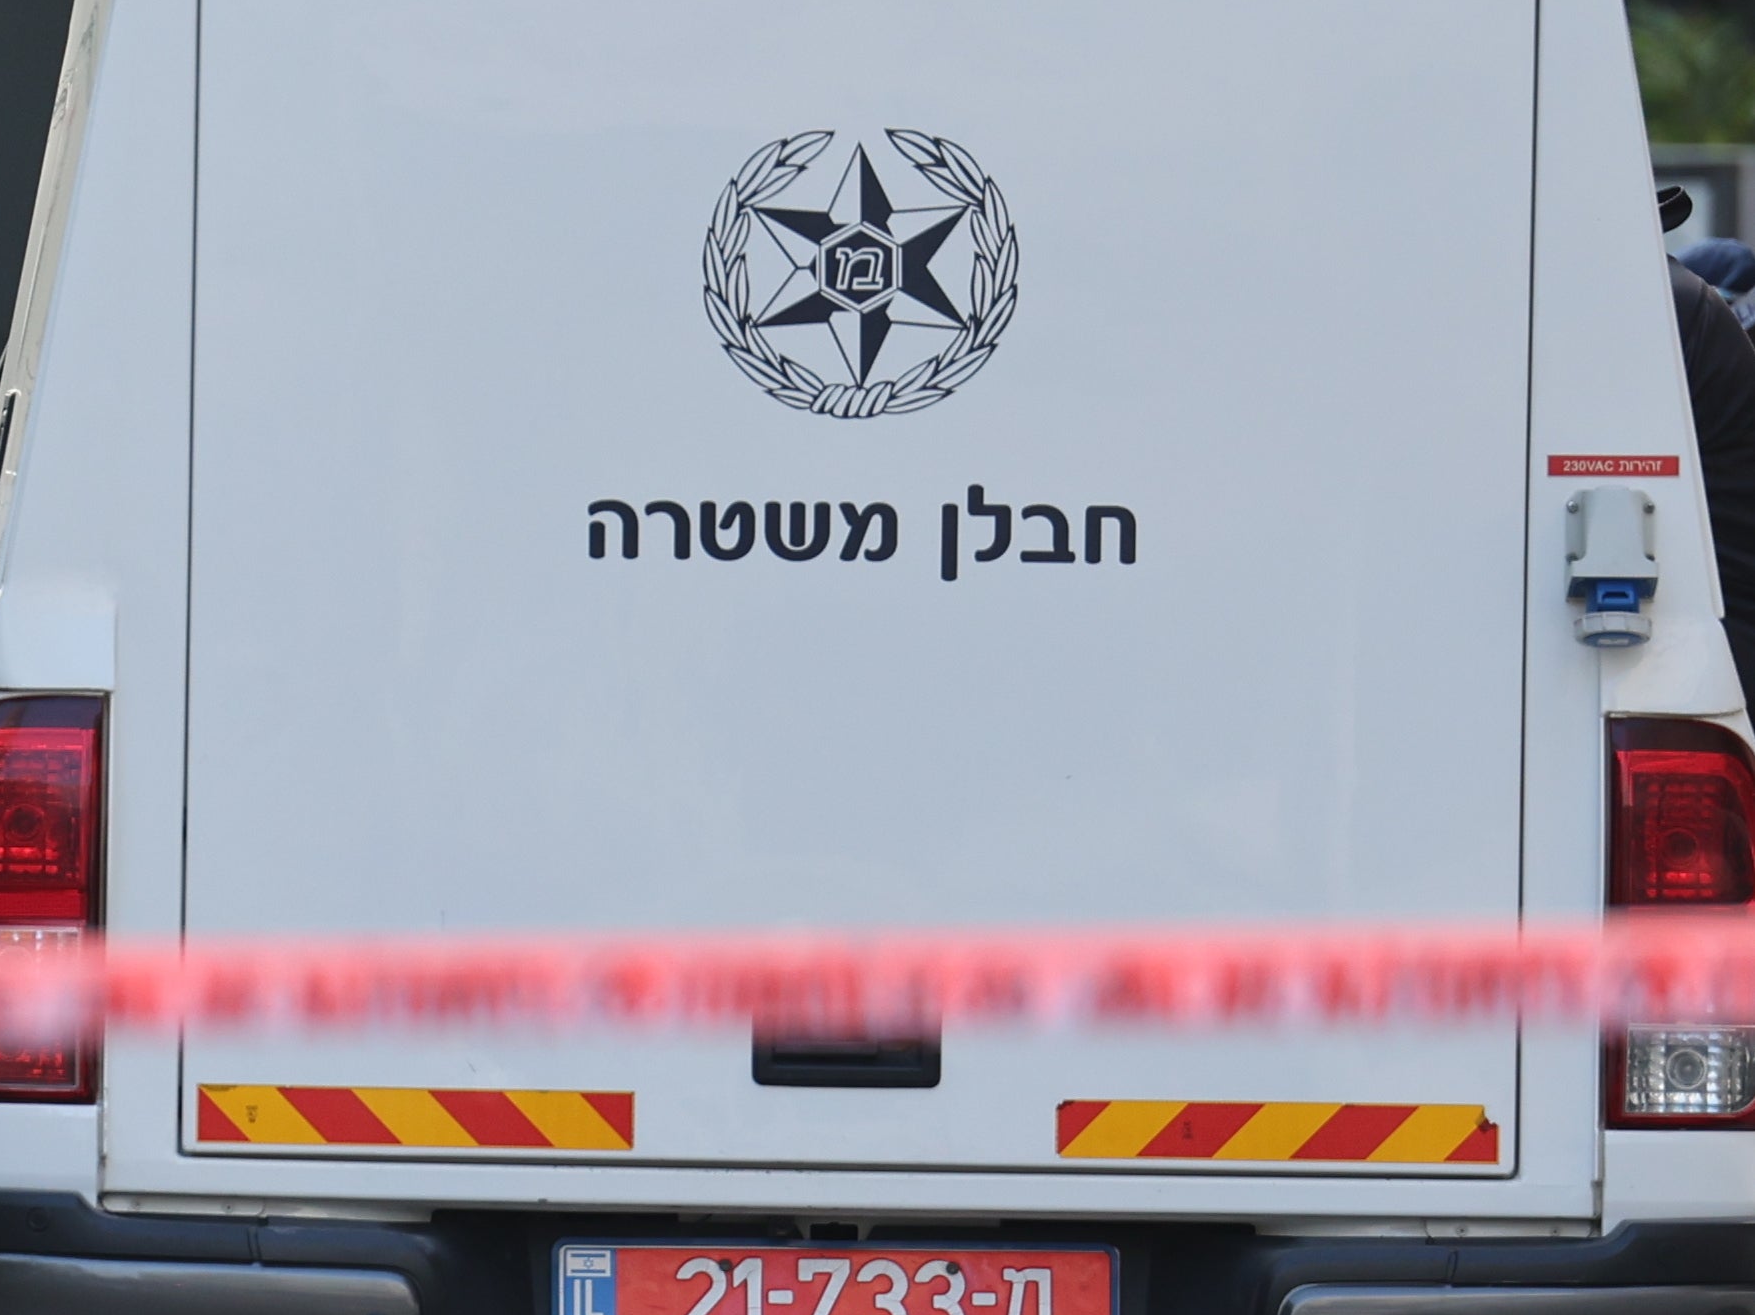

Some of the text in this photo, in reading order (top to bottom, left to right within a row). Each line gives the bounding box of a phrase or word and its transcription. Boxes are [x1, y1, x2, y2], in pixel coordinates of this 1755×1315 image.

[1563, 459, 1663, 472] זהירות 230VAC
[587, 483, 1138, 582] חבלן משטרה
